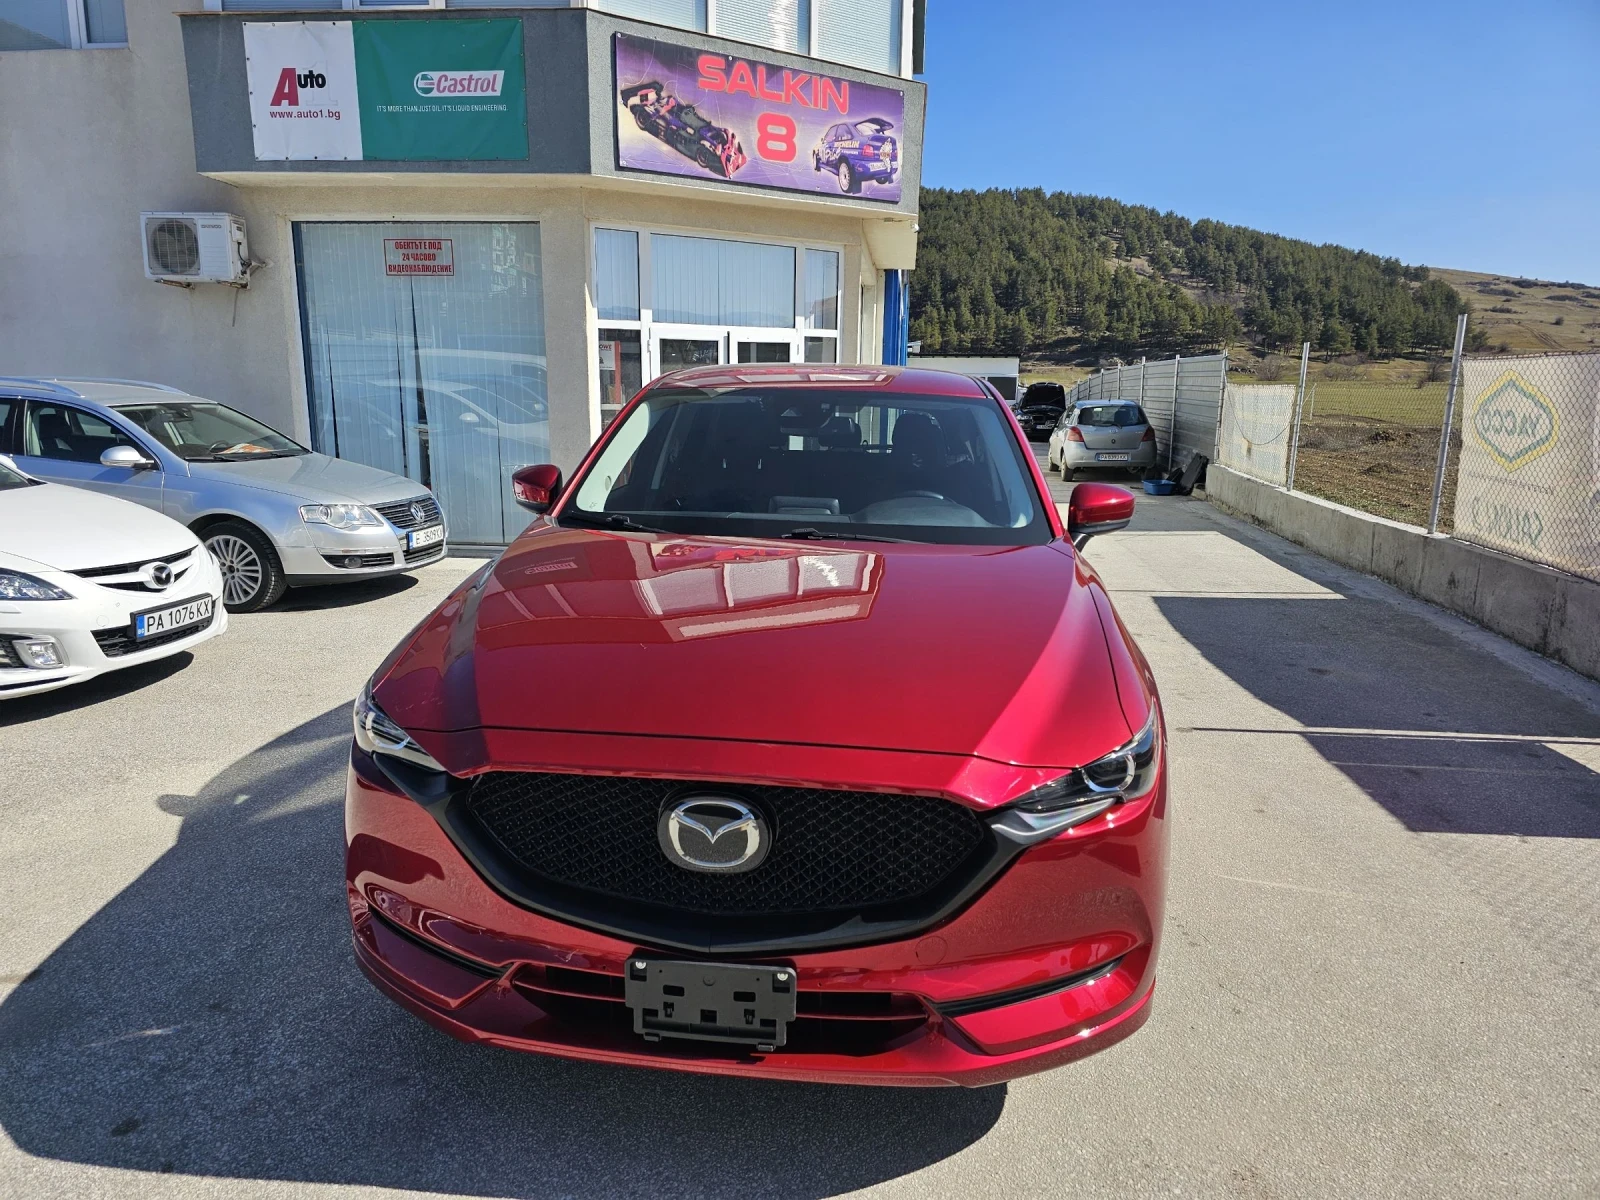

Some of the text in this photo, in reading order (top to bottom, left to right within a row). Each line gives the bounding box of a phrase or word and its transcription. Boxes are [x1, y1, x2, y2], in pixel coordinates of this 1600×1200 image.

[270, 67, 326, 106] Auto
[436, 74, 498, 94] Castrol
[699, 55, 848, 114] SALKIN
[270, 109, 341, 120] www.auto1.bg
[453, 104, 470, 112] LIQUID
[757, 112, 796, 163] 8
[394, 241, 442, 251] ОБЕКТЪТ Е ПОД
[402, 253, 436, 261] 24 ЧАСОВО
[388, 264, 452, 274] ВИДЕОНАБЛЮДЕНИЕ
[147, 613, 164, 632] PA
[169, 604, 195, 626] 1076
[196, 599, 210, 618] KX
